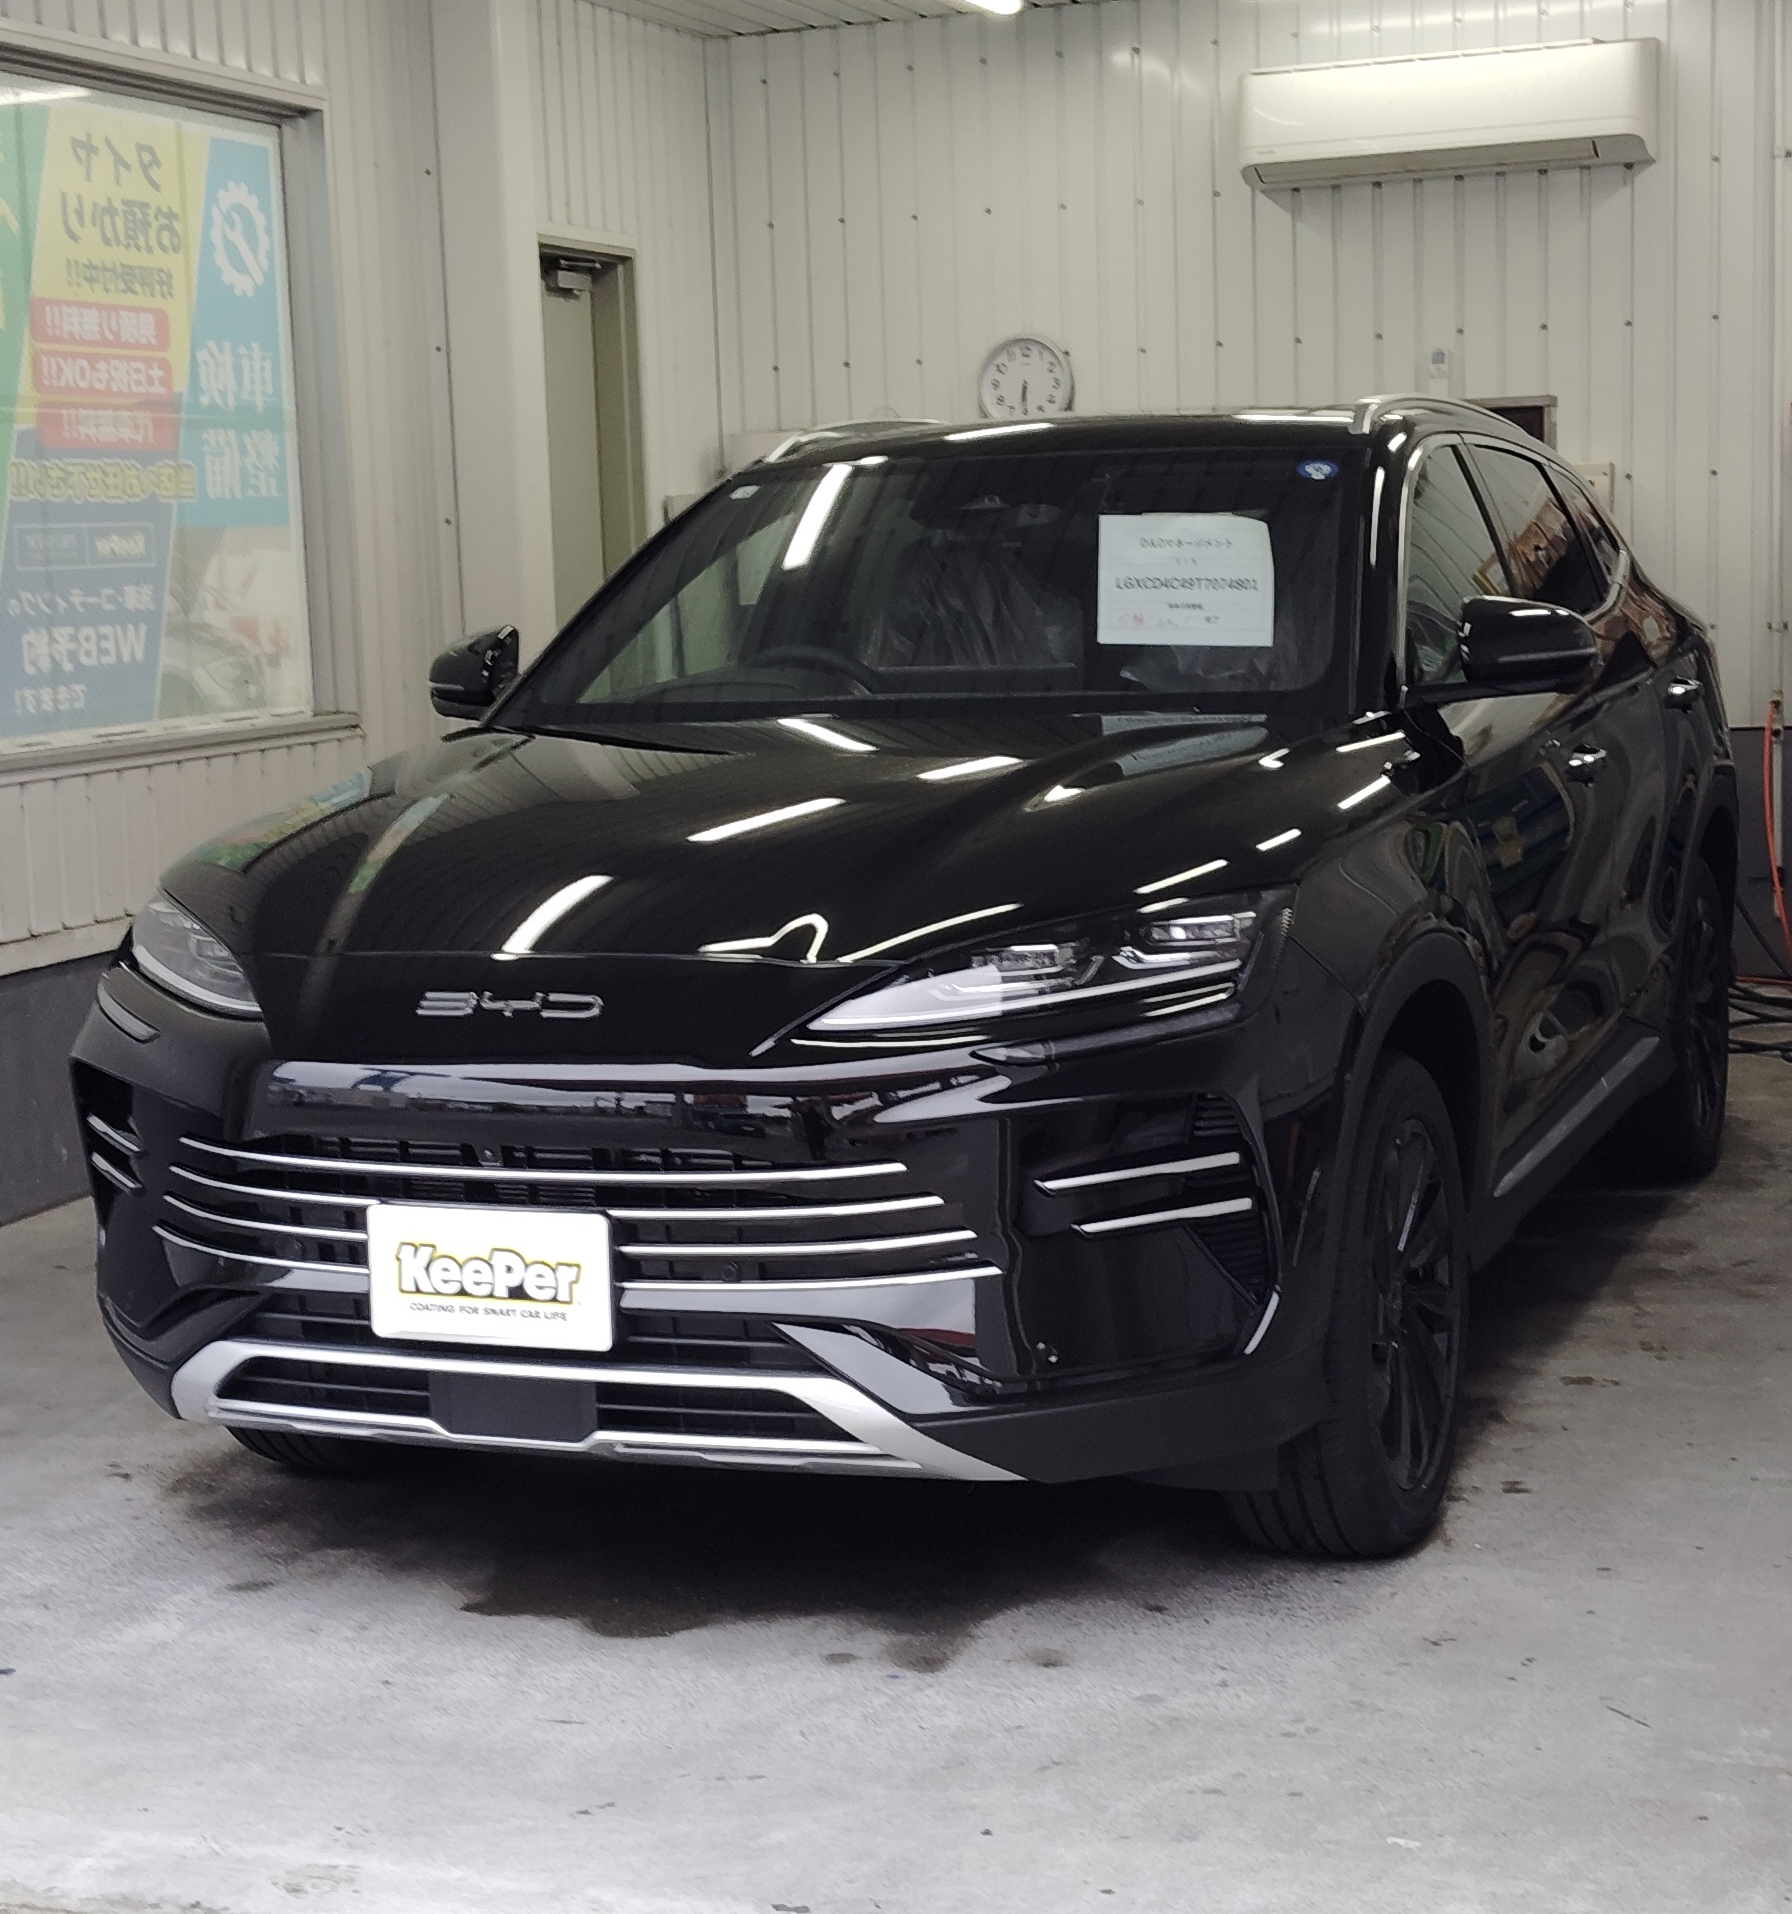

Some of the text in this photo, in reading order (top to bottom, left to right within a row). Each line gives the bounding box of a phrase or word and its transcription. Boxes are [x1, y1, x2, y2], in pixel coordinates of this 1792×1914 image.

[415, 991, 605, 1020] BYD
[395, 1241, 582, 1305] KeePer
[409, 1302, 456, 1314] COATING
[459, 1304, 480, 1315] FOR
[520, 1309, 542, 1320] CAR
[544, 1311, 569, 1322] LIFE
